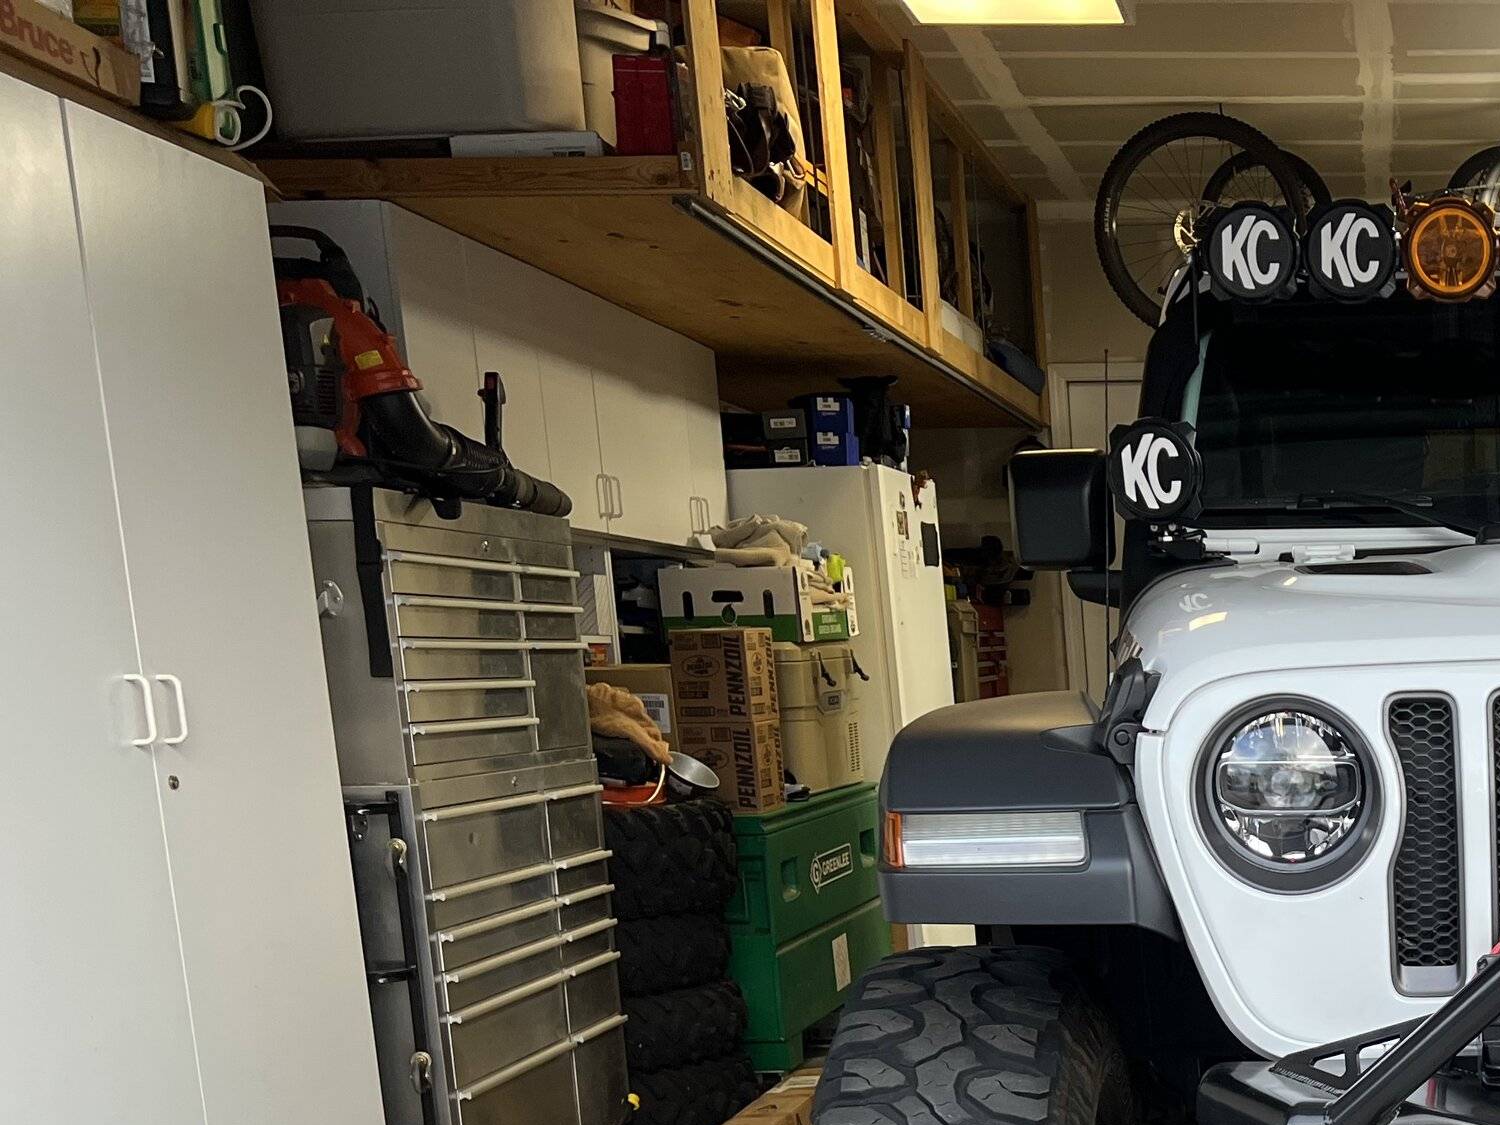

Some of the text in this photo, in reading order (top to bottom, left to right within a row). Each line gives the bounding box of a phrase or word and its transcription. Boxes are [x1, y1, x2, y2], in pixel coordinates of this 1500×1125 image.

[1221, 215, 1280, 290] KC
[1320, 212, 1380, 288] KC
[1121, 433, 1182, 509] KC
[722, 635, 747, 717] PENNZOIL
[764, 634, 778, 714] PENNZOIL
[733, 727, 758, 810] PENNZOIL
[822, 852, 850, 876] GREENLEE
